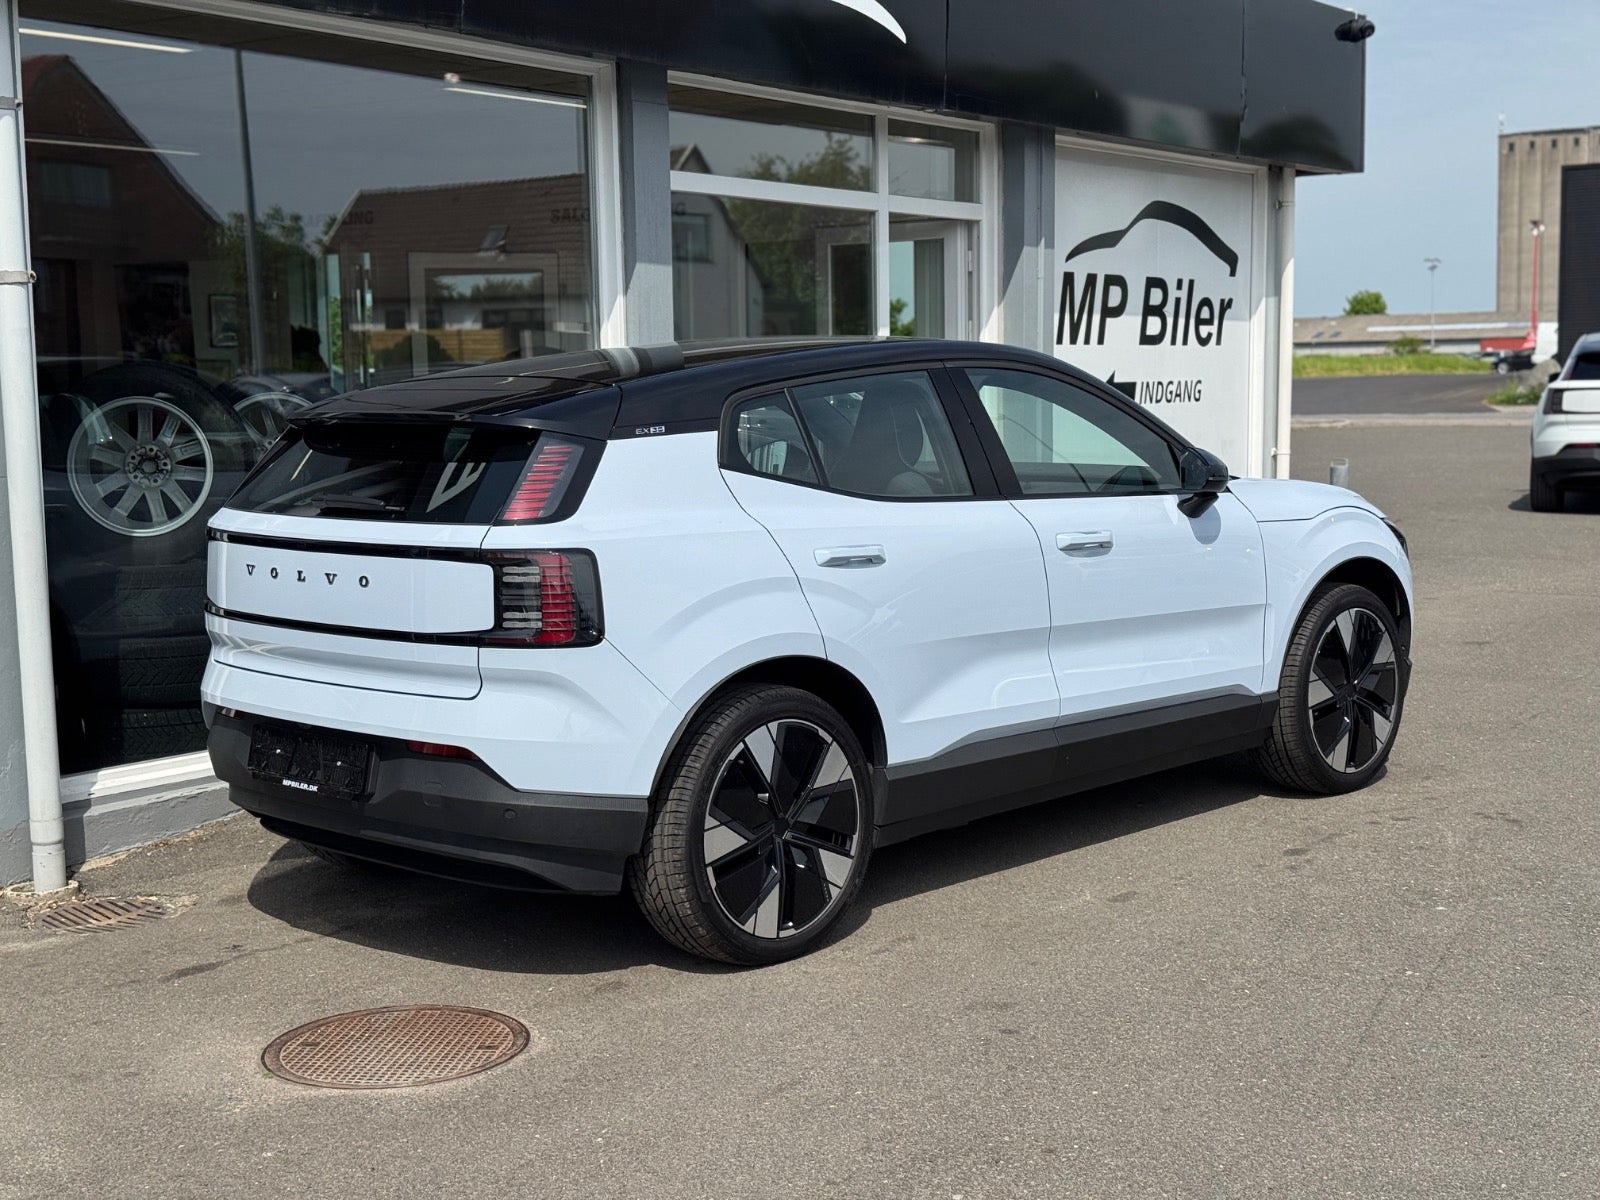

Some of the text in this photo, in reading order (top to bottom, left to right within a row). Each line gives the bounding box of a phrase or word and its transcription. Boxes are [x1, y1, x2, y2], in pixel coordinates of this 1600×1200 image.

[1056, 271, 1234, 347] MP Biler
[1139, 379, 1203, 405] INDGANG
[246, 563, 370, 589] VOLVO
